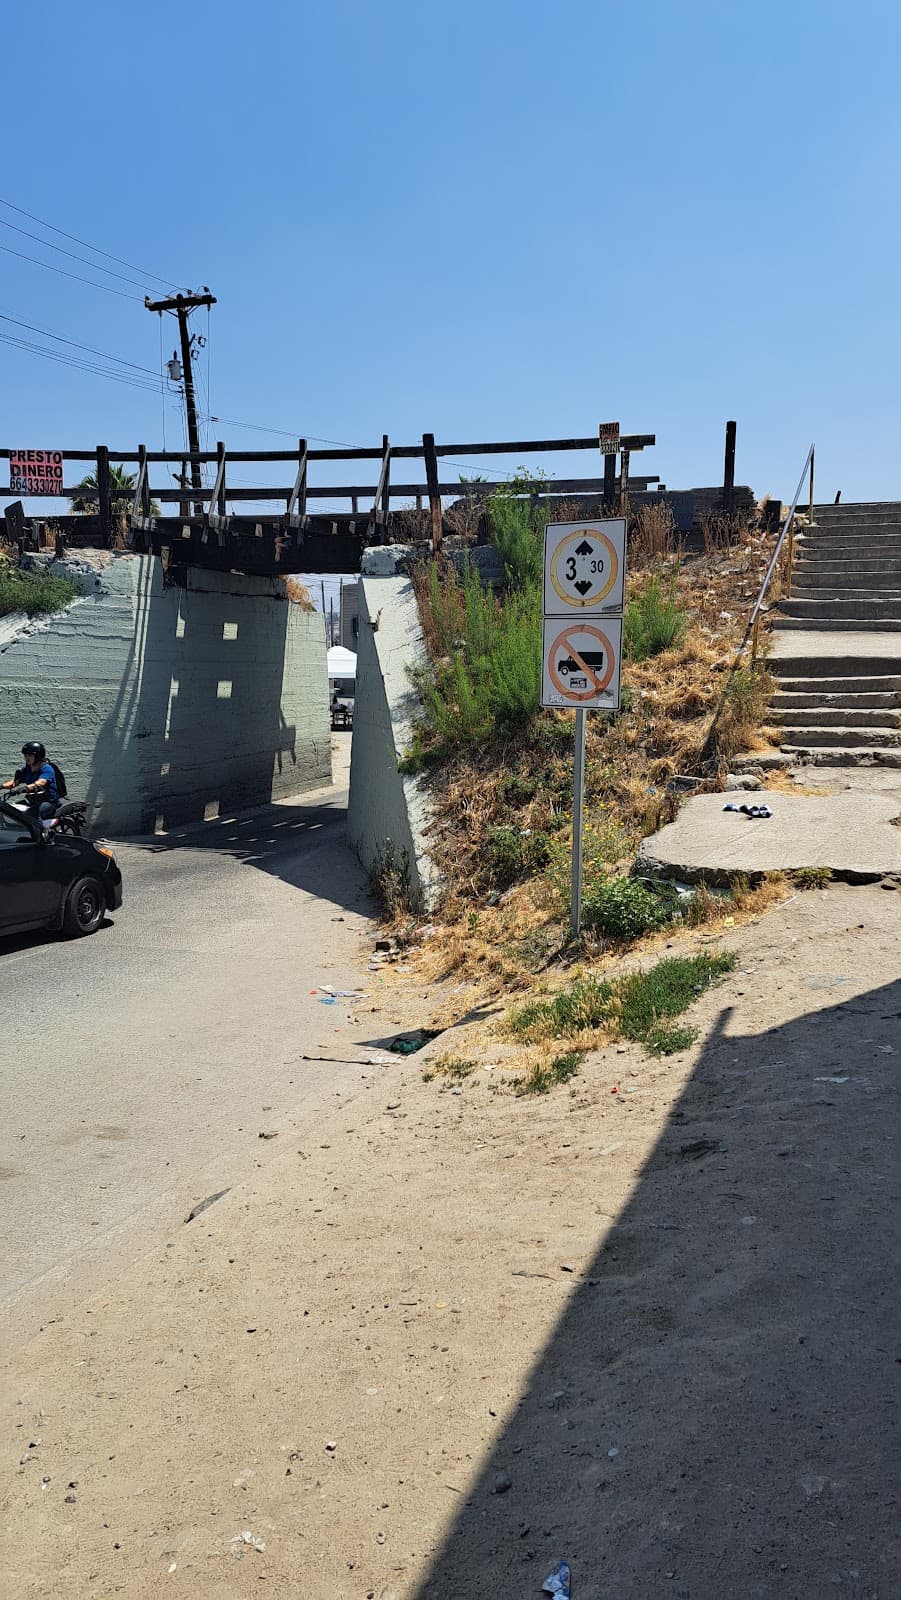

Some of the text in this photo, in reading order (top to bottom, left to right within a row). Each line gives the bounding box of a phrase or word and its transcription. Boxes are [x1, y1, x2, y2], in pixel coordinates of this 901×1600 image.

[10, 450, 62, 464] PRESTO
[10, 464, 63, 478] DINERO
[10, 477, 63, 494] 6643330270
[566, 557, 604, 581] 3 30
